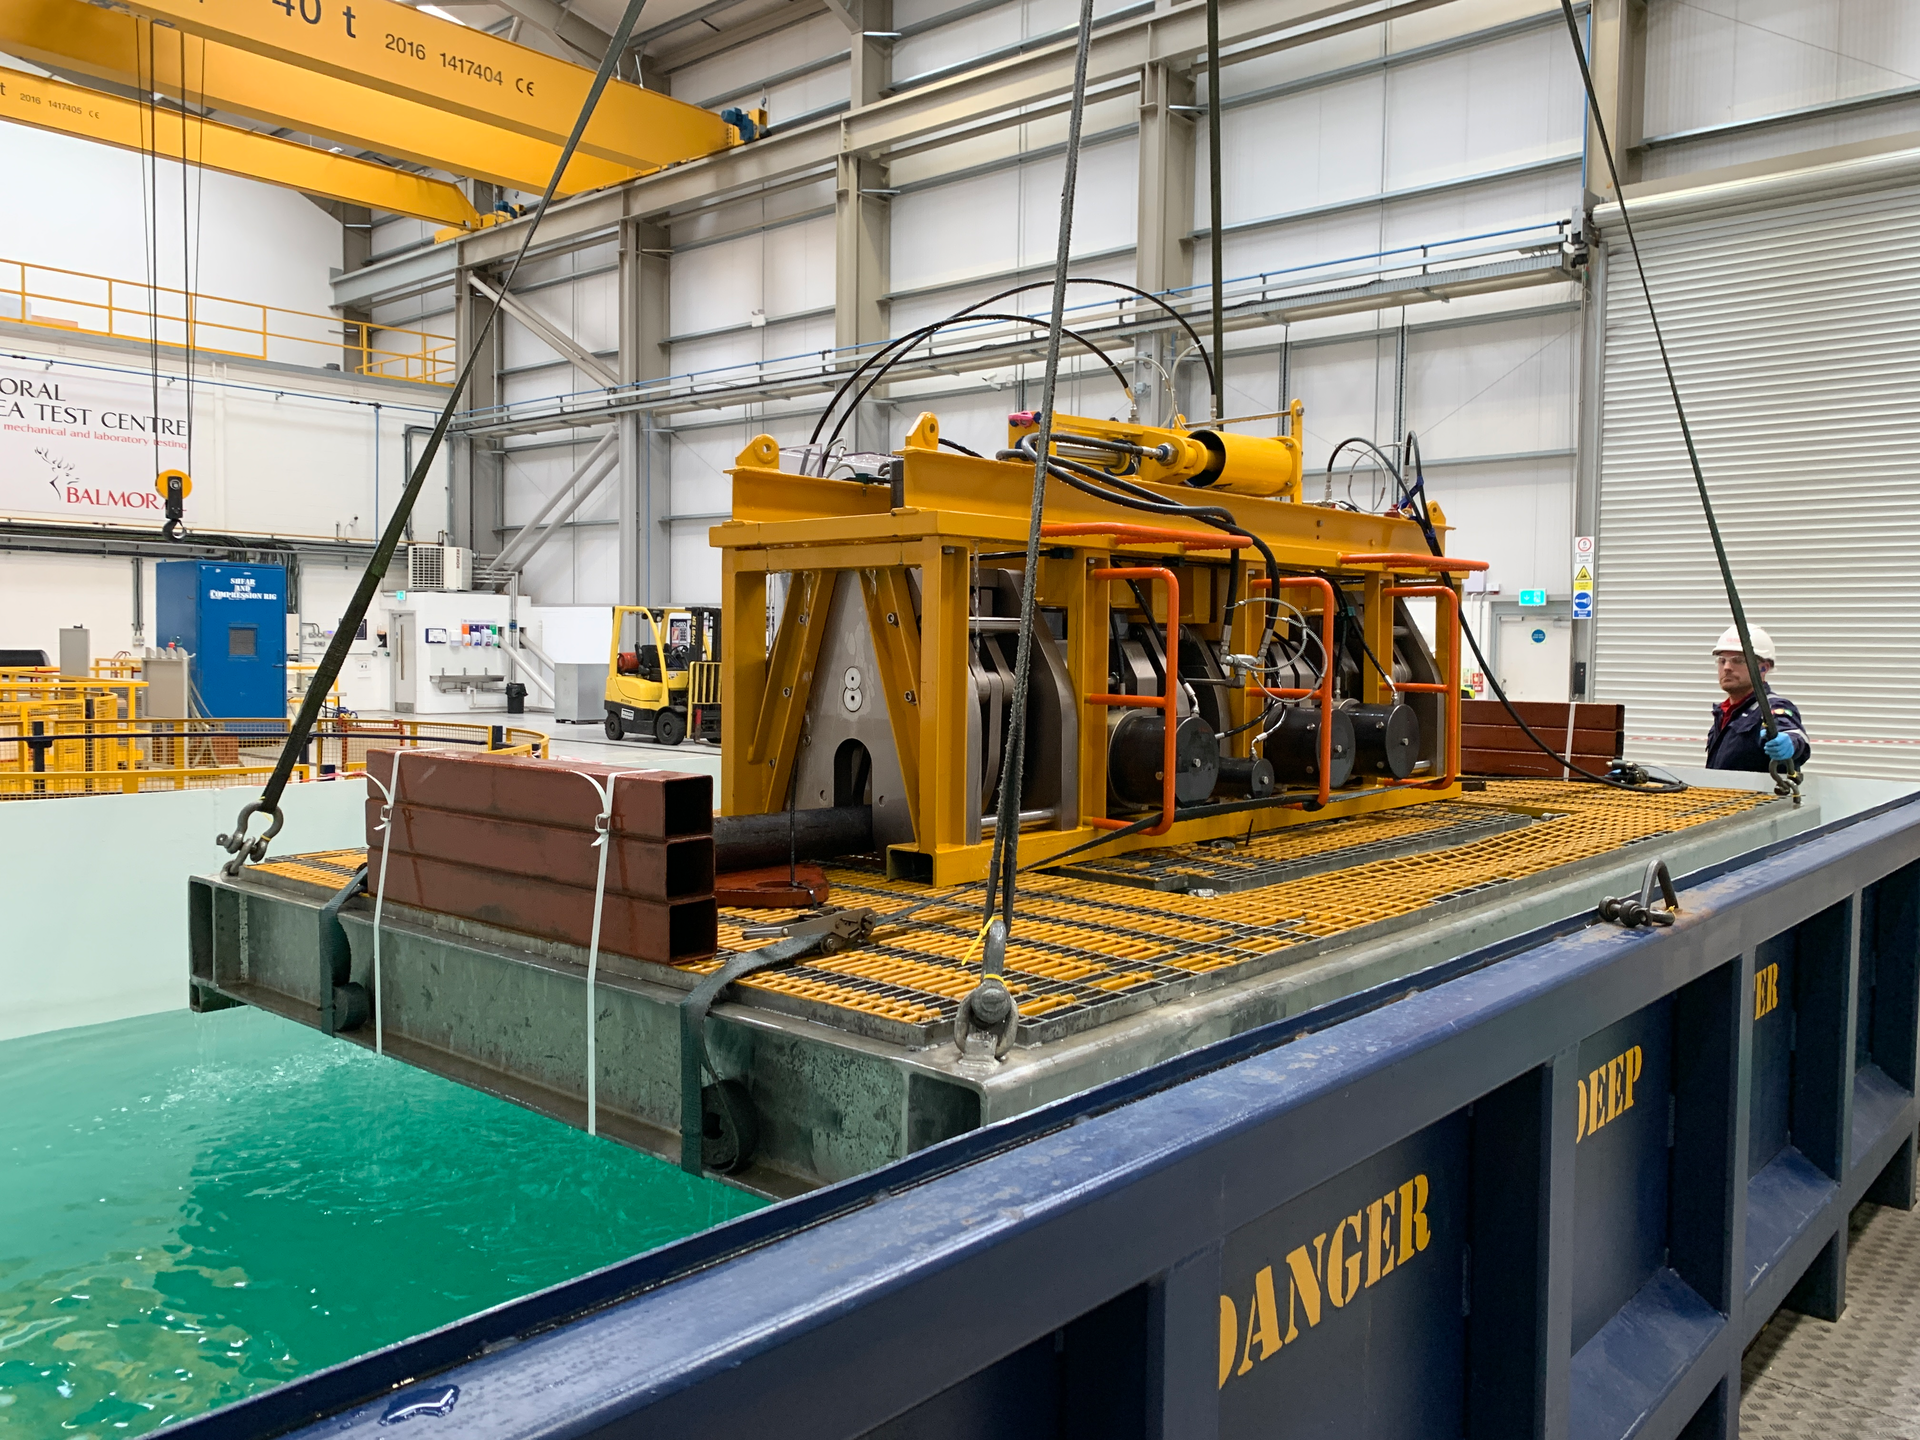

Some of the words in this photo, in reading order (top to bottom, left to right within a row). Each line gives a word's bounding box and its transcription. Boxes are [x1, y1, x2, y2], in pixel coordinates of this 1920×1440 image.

[342, 5, 356, 39] t
[385, 33, 426, 61] 2016
[440, 52, 503, 86] 1417404
[515, 77, 534, 97] CE
[20, 93, 41, 105] 2016
[48, 100, 82, 115] 1417405
[34, 403, 92, 425] TEST
[101, 411, 187, 437] CENTRE
[4, 423, 66, 437] mechanical
[70, 429, 91, 439] and
[94, 431, 149, 446] laboratory
[153, 438, 187, 450] testing
[66, 486, 187, 512] BALMOR
[210, 591, 263, 600] COMPRESSION
